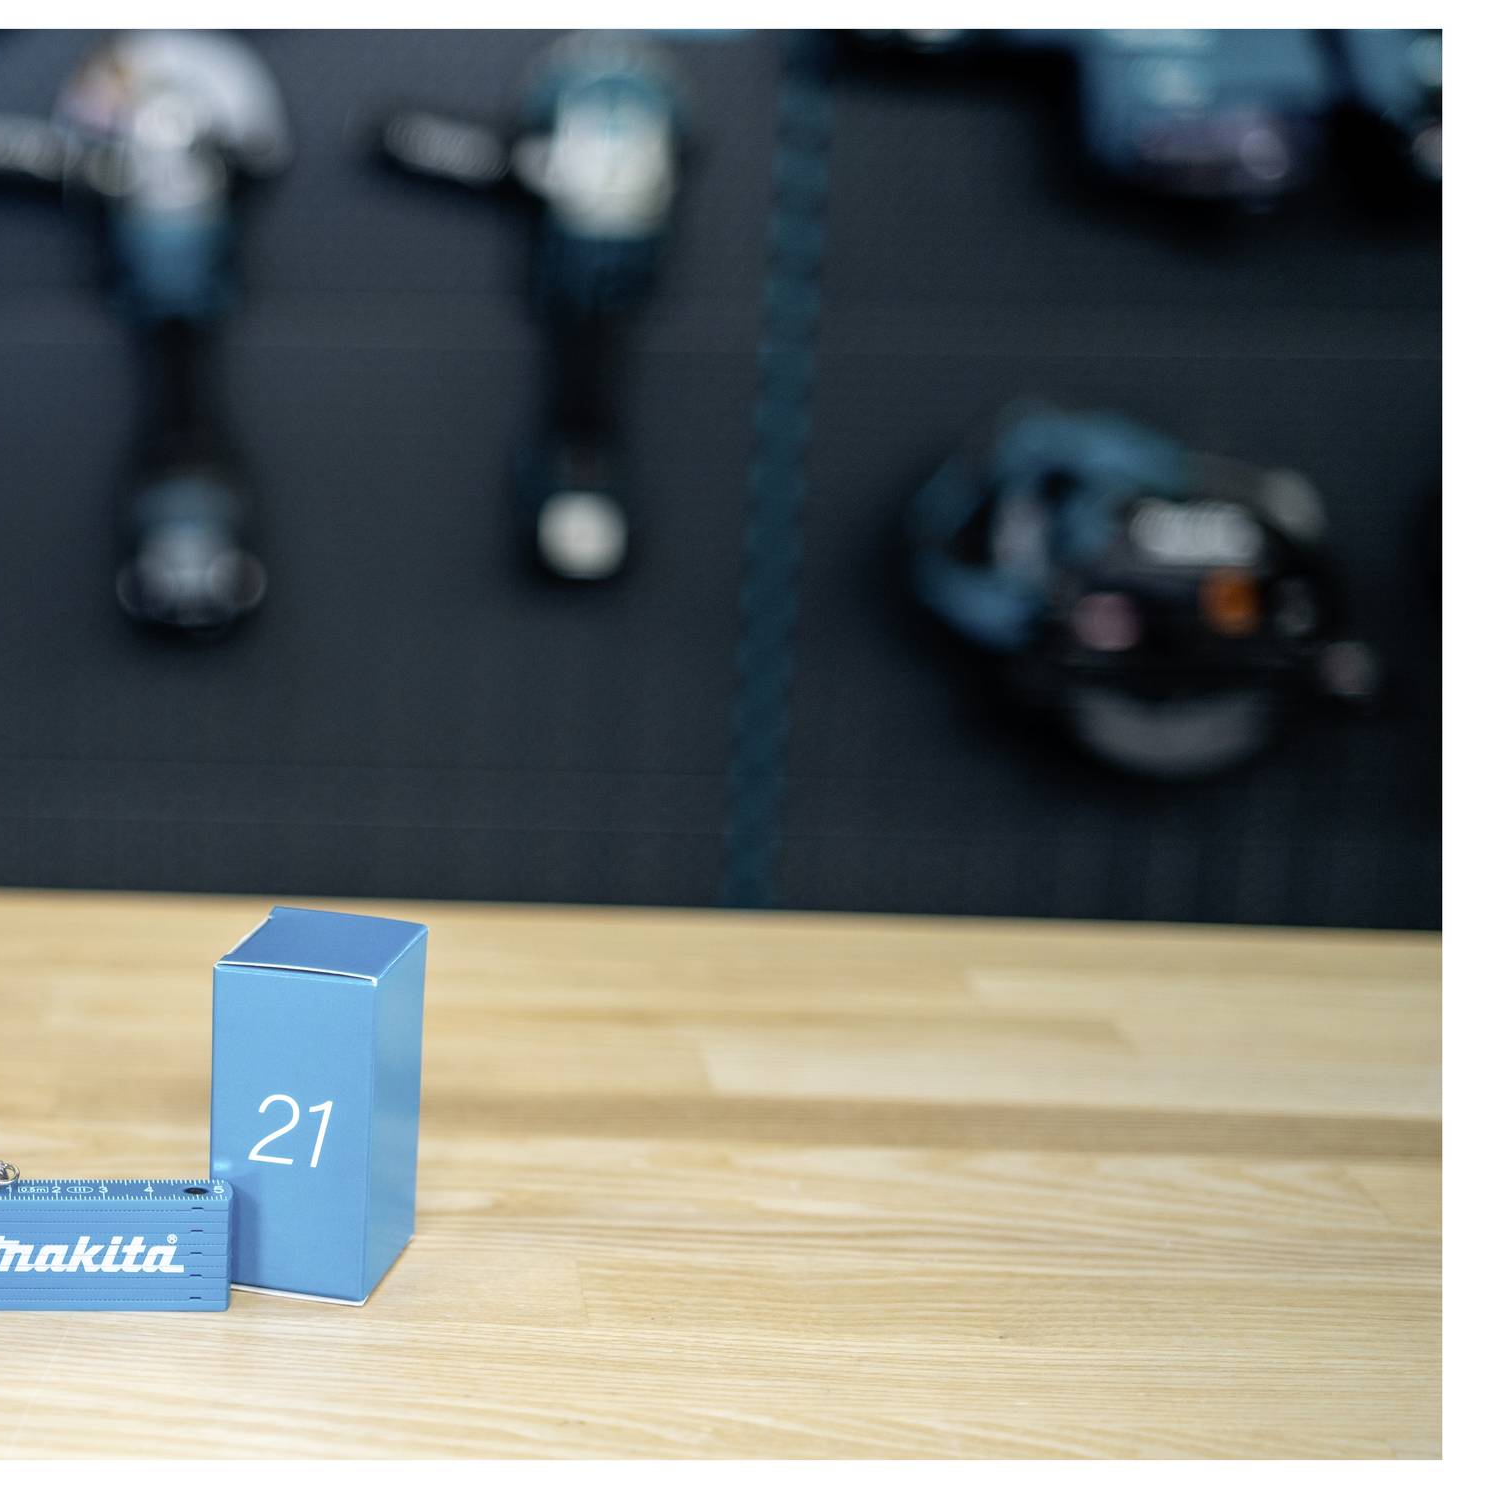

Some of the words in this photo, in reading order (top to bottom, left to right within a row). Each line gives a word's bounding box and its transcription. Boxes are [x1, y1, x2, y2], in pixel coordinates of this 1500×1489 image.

[247, 1094, 334, 1168] 21
[51, 1186, 61, 1194] 2
[99, 1186, 109, 1194] 3
[143, 1185, 155, 1193] 4
[213, 1185, 225, 1194] 5
